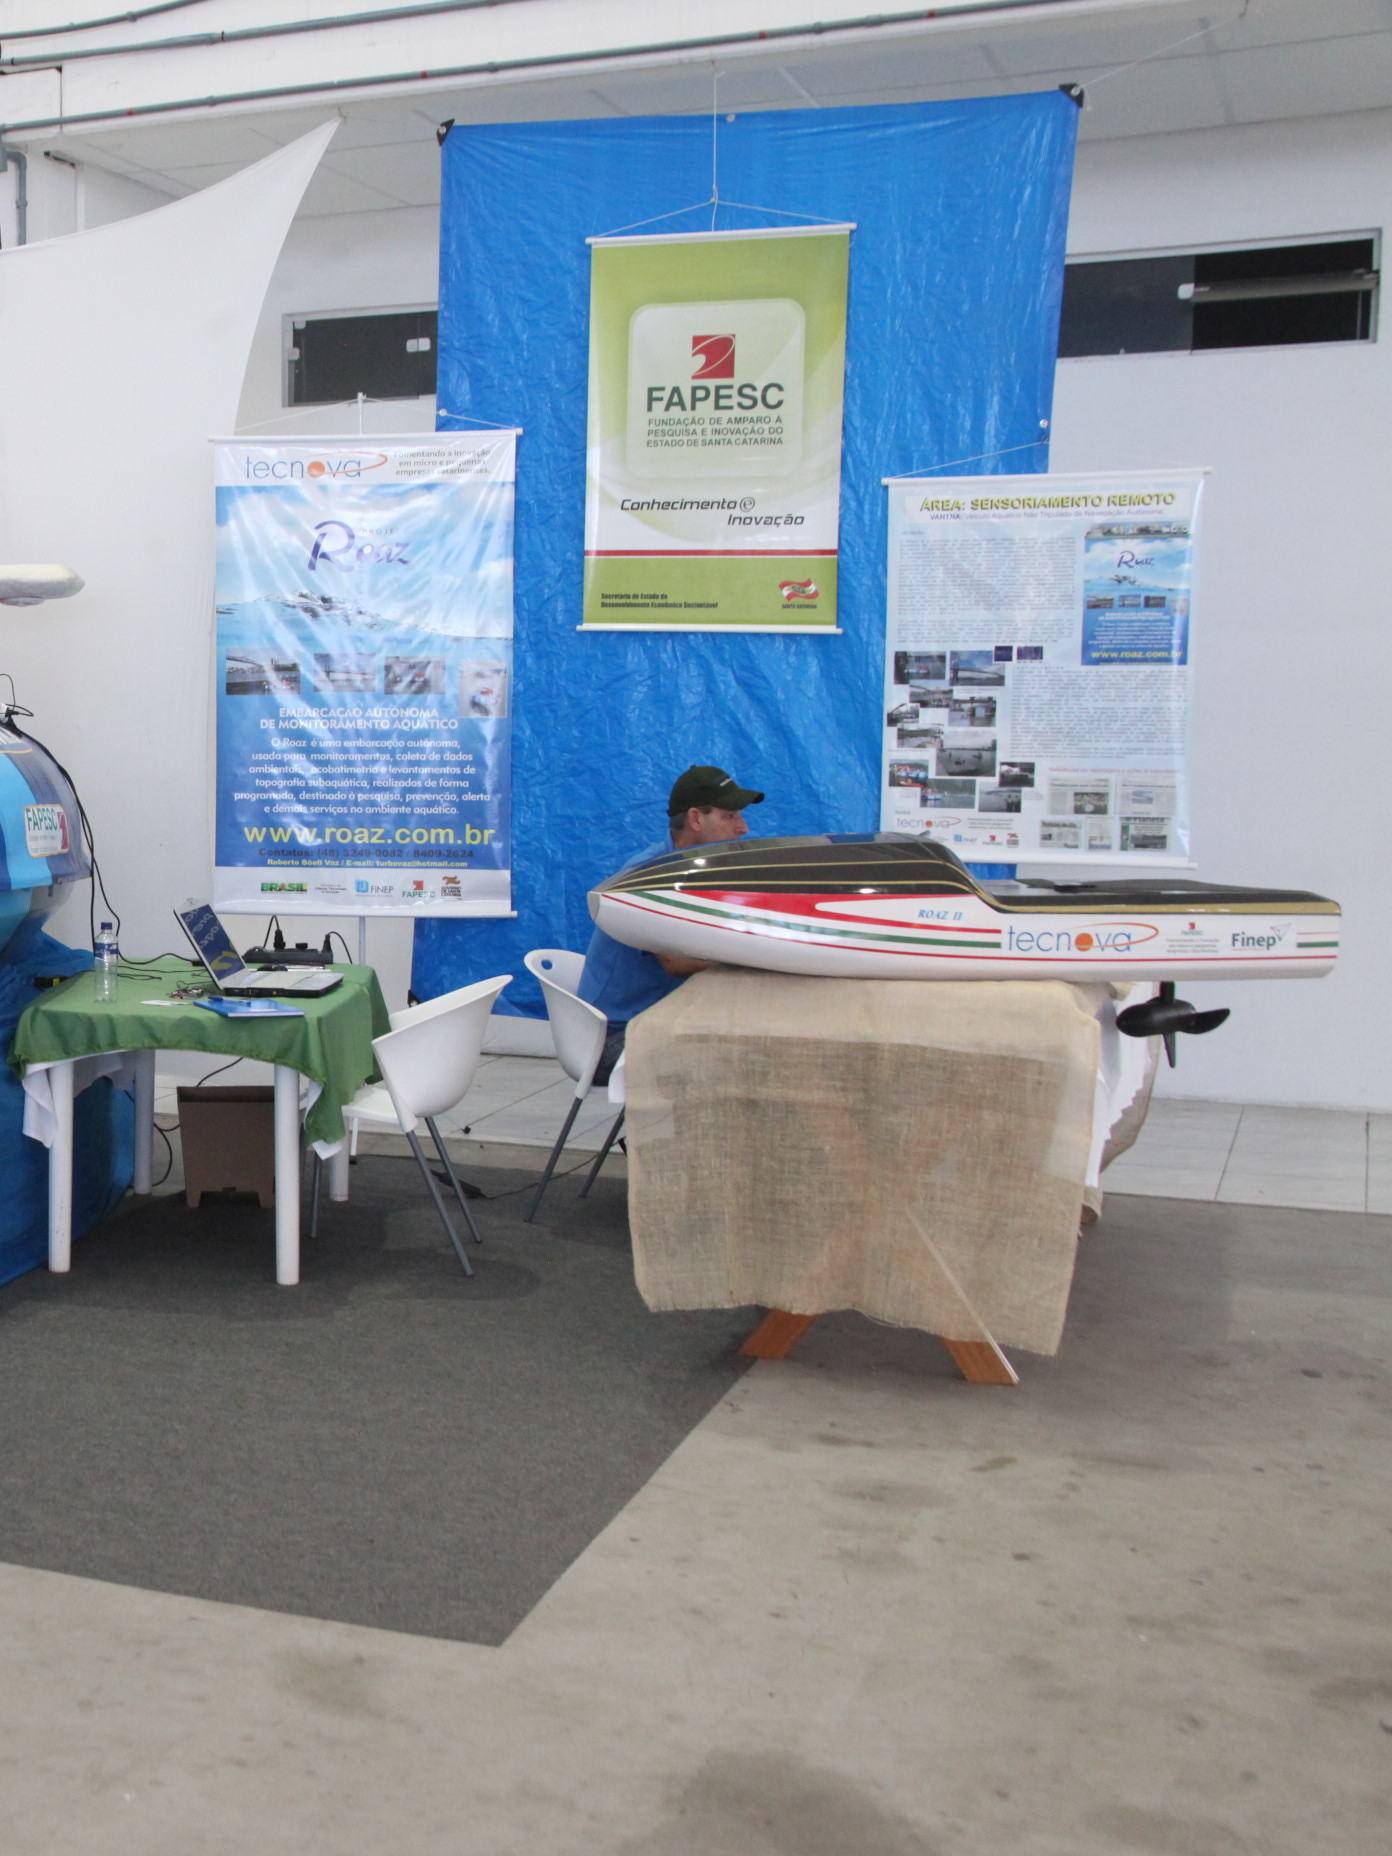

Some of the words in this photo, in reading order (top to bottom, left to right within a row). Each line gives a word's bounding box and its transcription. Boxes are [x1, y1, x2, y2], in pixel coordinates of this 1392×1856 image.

[647, 382, 785, 412] FAPESC
[648, 416, 705, 427] FUNDAÇÃO
[709, 417, 722, 425] DE
[726, 415, 771, 425] AMPARO
[648, 428, 698, 438] PESQUISA
[701, 428, 708, 436] E
[711, 425, 765, 437] INOVAÇÃO
[768, 426, 784, 435] DO
[647, 439, 685, 448] ESTADO
[686, 439, 699, 447] DE
[701, 438, 733, 446] SANTA
[735, 437, 783, 446] CATARINA
[454, 449, 490, 458] inovção
[246, 456, 362, 479] tecnova
[620, 498, 737, 511] Conhecimento
[970, 494, 1103, 510] SENSORIAMENTO
[1107, 492, 1176, 506] REMOTO
[727, 513, 805, 528] Inovação
[308, 520, 410, 573] Roaz
[279, 706, 362, 718] EMBARCAÇÃO
[365, 705, 439, 718] AUTÔNOMA
[260, 719, 276, 729] DE
[278, 719, 390, 729] MONITORAMENTO
[392, 718, 459, 731] AQUÁTICO
[271, 738, 280, 747] O
[283, 738, 307, 747] Roaz
[311, 738, 317, 747] é
[344, 738, 404, 749] embarcação
[407, 738, 460, 748] autônoma,
[252, 752, 281, 760] usada
[284, 753, 306, 762] para
[311, 752, 393, 761] monitoramentos,
[396, 752, 426, 760] coleta
[428, 752, 441, 760] de
[443, 752, 473, 761] dados
[389, 765, 461, 774] levantamentos
[463, 765, 476, 774] de
[255, 778, 306, 788] topografia
[372, 778, 422, 787] realizados
[424, 778, 437, 787] de
[439, 778, 469, 787] forma
[234, 792, 296, 801] programada,
[299, 792, 346, 800] destinado
[358, 792, 403, 802] pesquisa,
[406, 793, 459, 802] prevenção,
[462, 792, 491, 801] alerta
[272, 804, 307, 813] demais
[310, 805, 348, 815] serviços
[365, 805, 411, 813] ambiente
[413, 805, 459, 815] aquático.
[26, 807, 58, 831] FAPESC
[897, 817, 950, 828] tecnova
[244, 823, 495, 844] www.roaz.com.br
[259, 848, 313, 857] Contatos:
[317, 849, 339, 858] (48)
[260, 882, 307, 892] BRASIL
[370, 886, 393, 894] FINEP
[402, 890, 436, 898] FAPESC
[918, 909, 949, 920] ROAZ
[953, 911, 963, 921] II
[1007, 925, 1131, 952] tecnova
[1231, 931, 1277, 951] Finep
